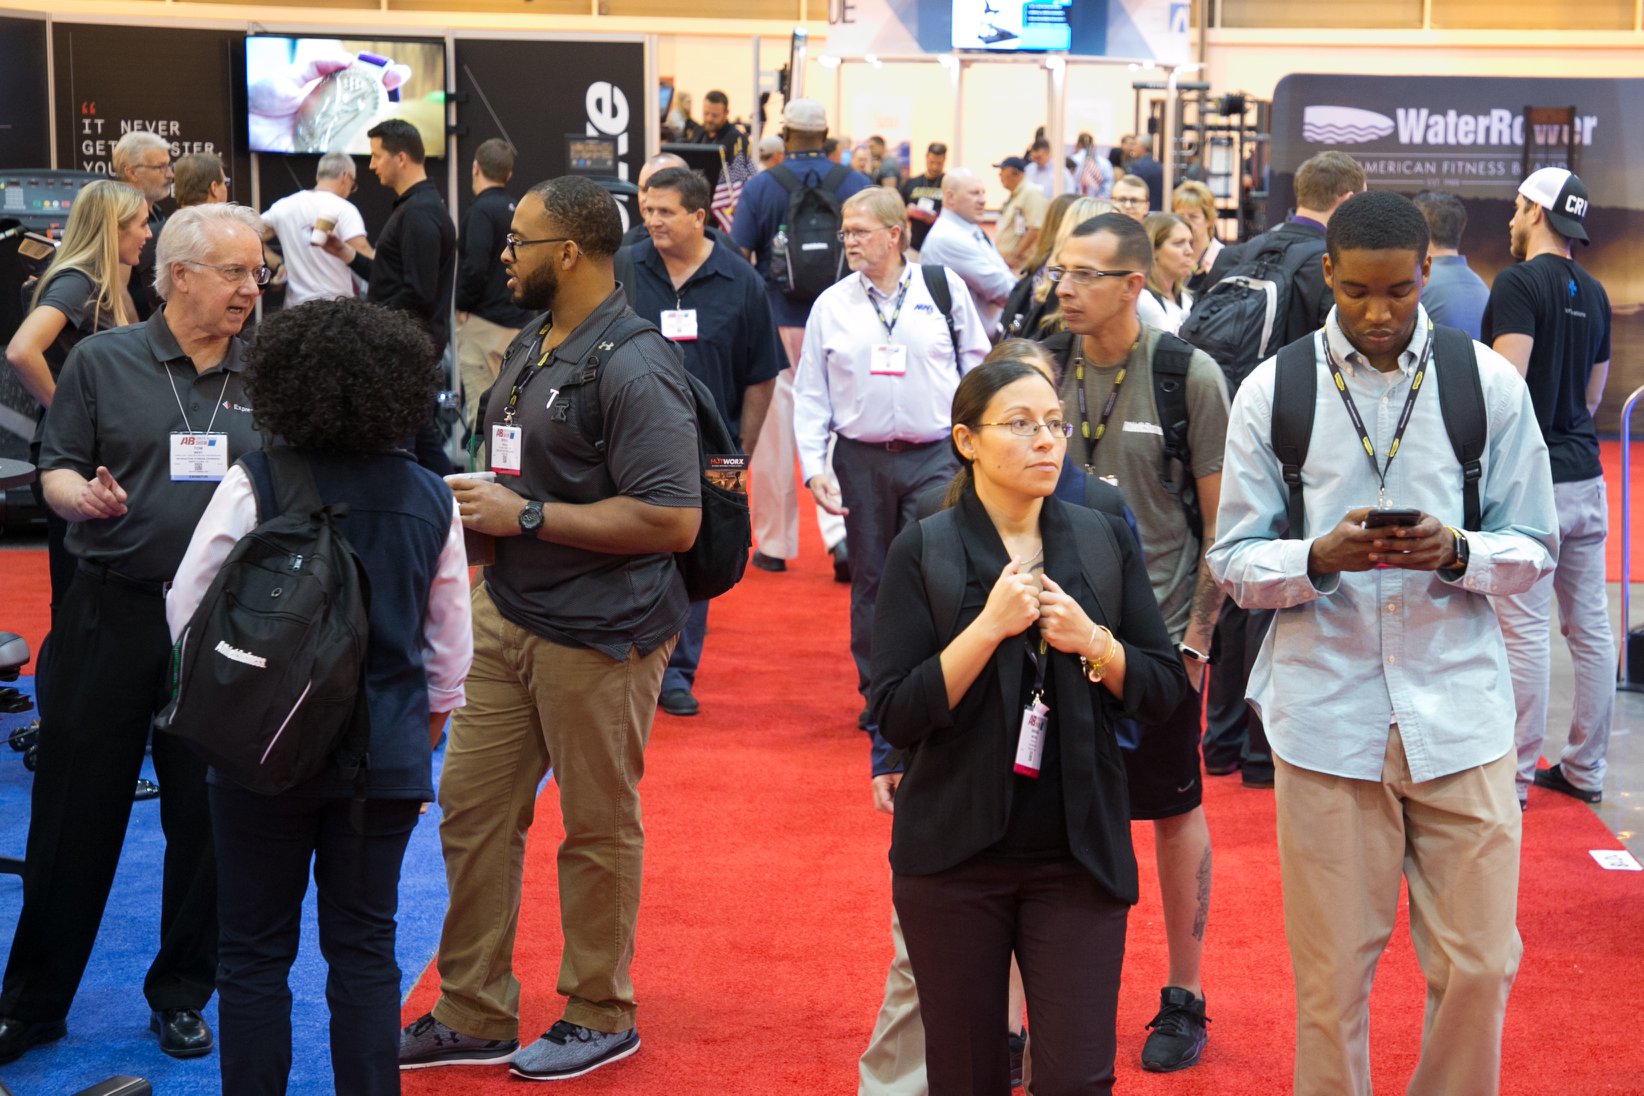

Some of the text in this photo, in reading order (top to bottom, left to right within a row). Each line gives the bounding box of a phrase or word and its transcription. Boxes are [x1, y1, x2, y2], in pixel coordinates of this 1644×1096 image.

[82, 119, 181, 136] IT NEVER
[82, 140, 223, 158] GET SIER,
[1442, 159, 1506, 175] FITNESS
[1511, 159, 1568, 175] BAND
[180, 436, 196, 446] AB
